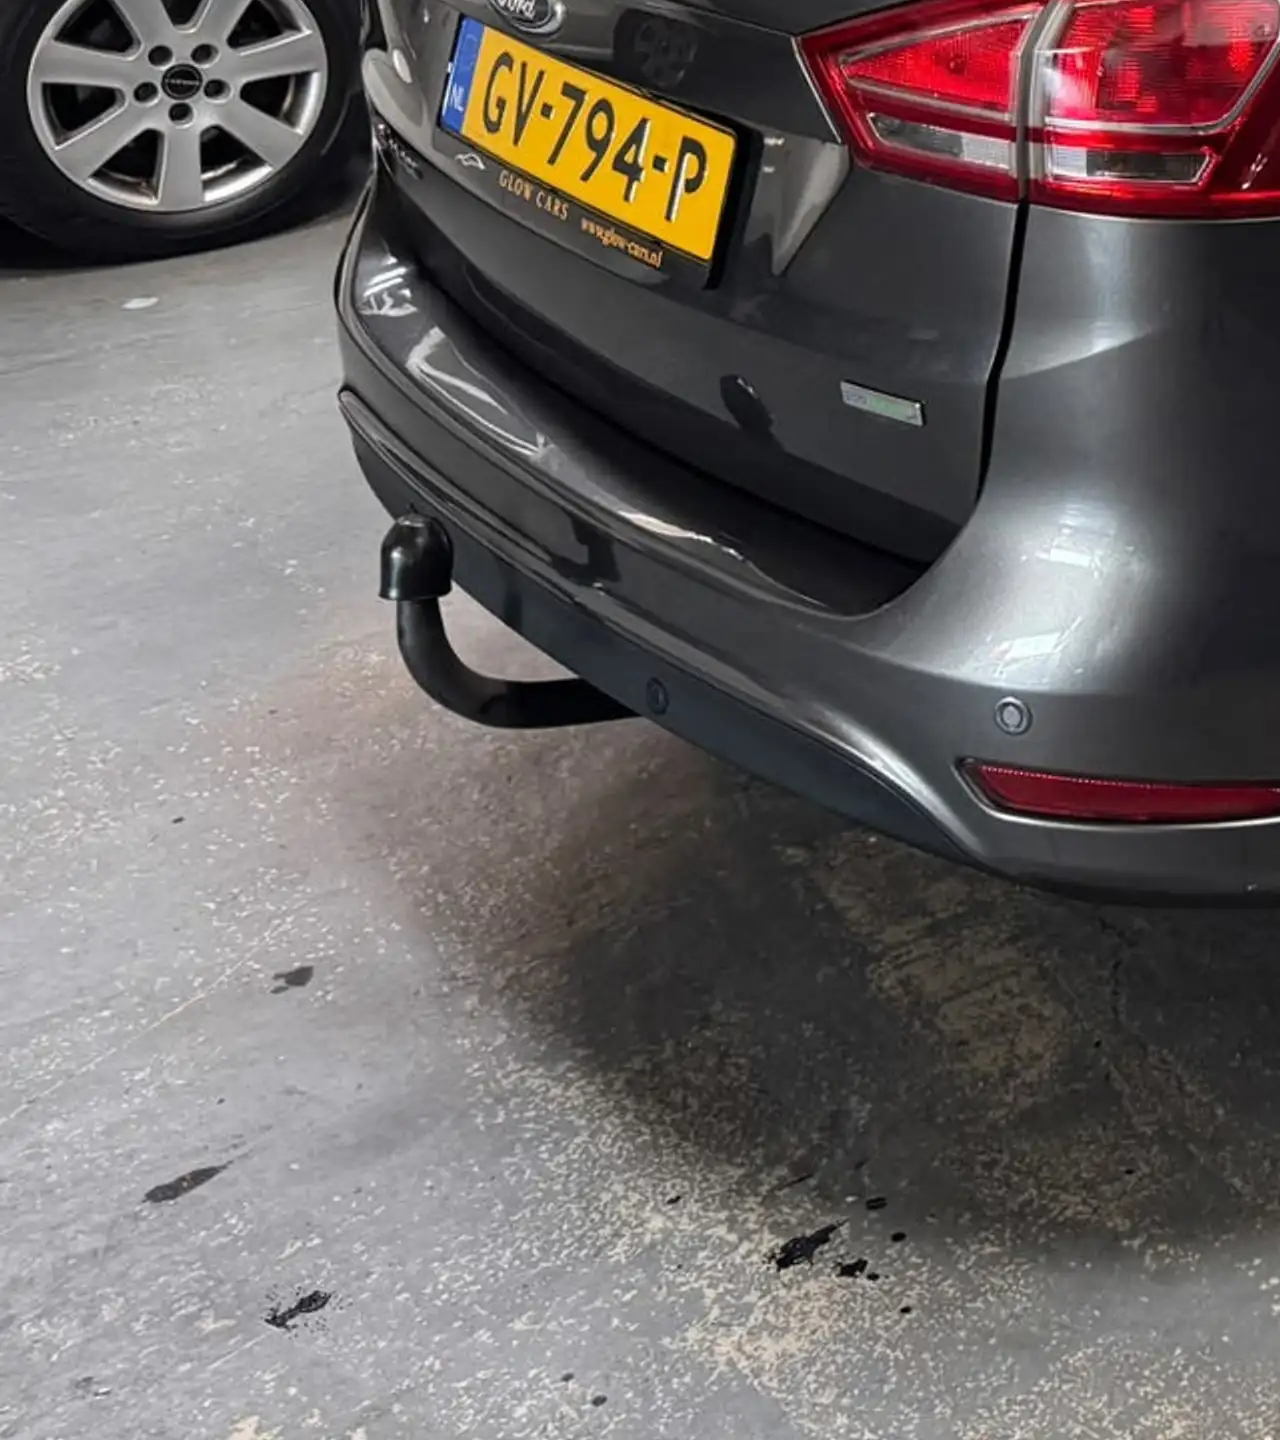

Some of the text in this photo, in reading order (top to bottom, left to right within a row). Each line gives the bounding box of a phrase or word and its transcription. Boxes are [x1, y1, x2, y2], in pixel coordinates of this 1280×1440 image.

[449, 83, 465, 112] NL
[482, 51, 708, 223] GV-794-P
[499, 169, 535, 201] GLOW
[535, 190, 570, 221] CARS
